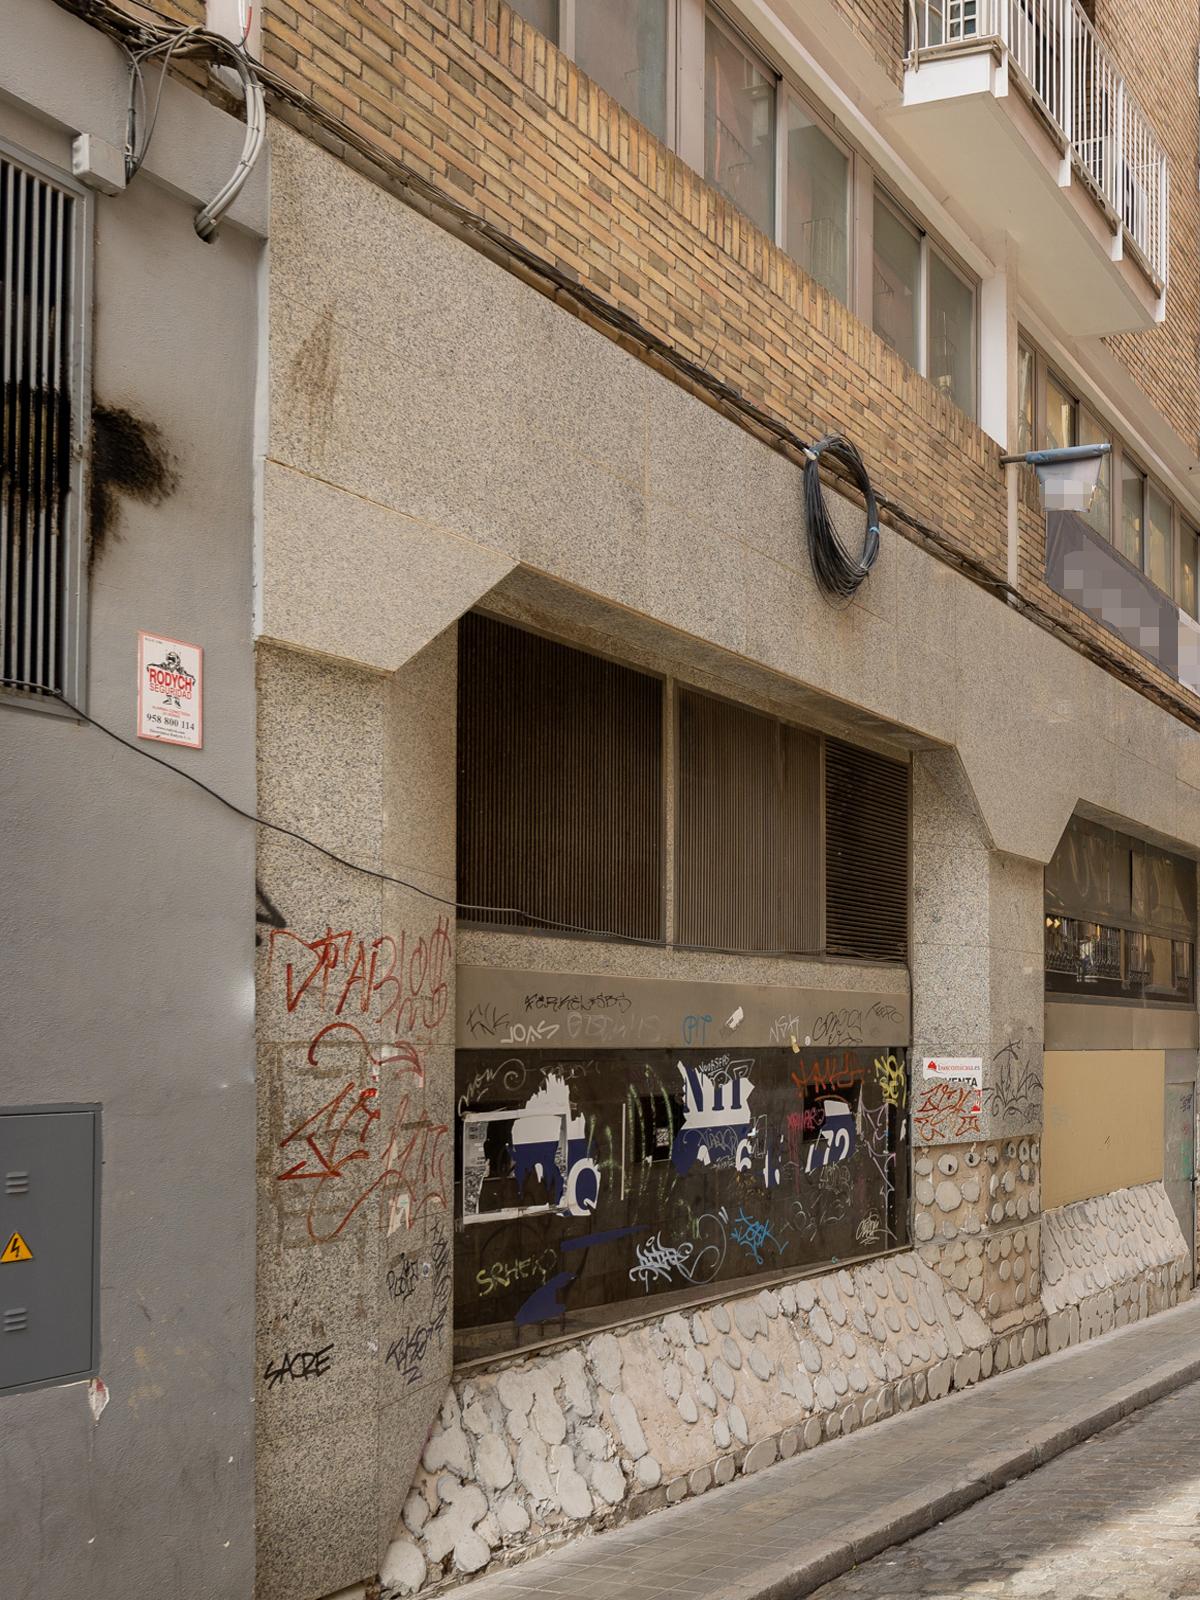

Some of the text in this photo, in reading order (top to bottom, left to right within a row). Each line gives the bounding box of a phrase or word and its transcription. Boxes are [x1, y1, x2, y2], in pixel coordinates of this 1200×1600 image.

[149, 668, 193, 692] RODYCH
[149, 682, 193, 700] SEGURIDAD
[146, 712, 162, 725] 958
[163, 717, 179, 729] 800
[181, 720, 196, 731] 114
